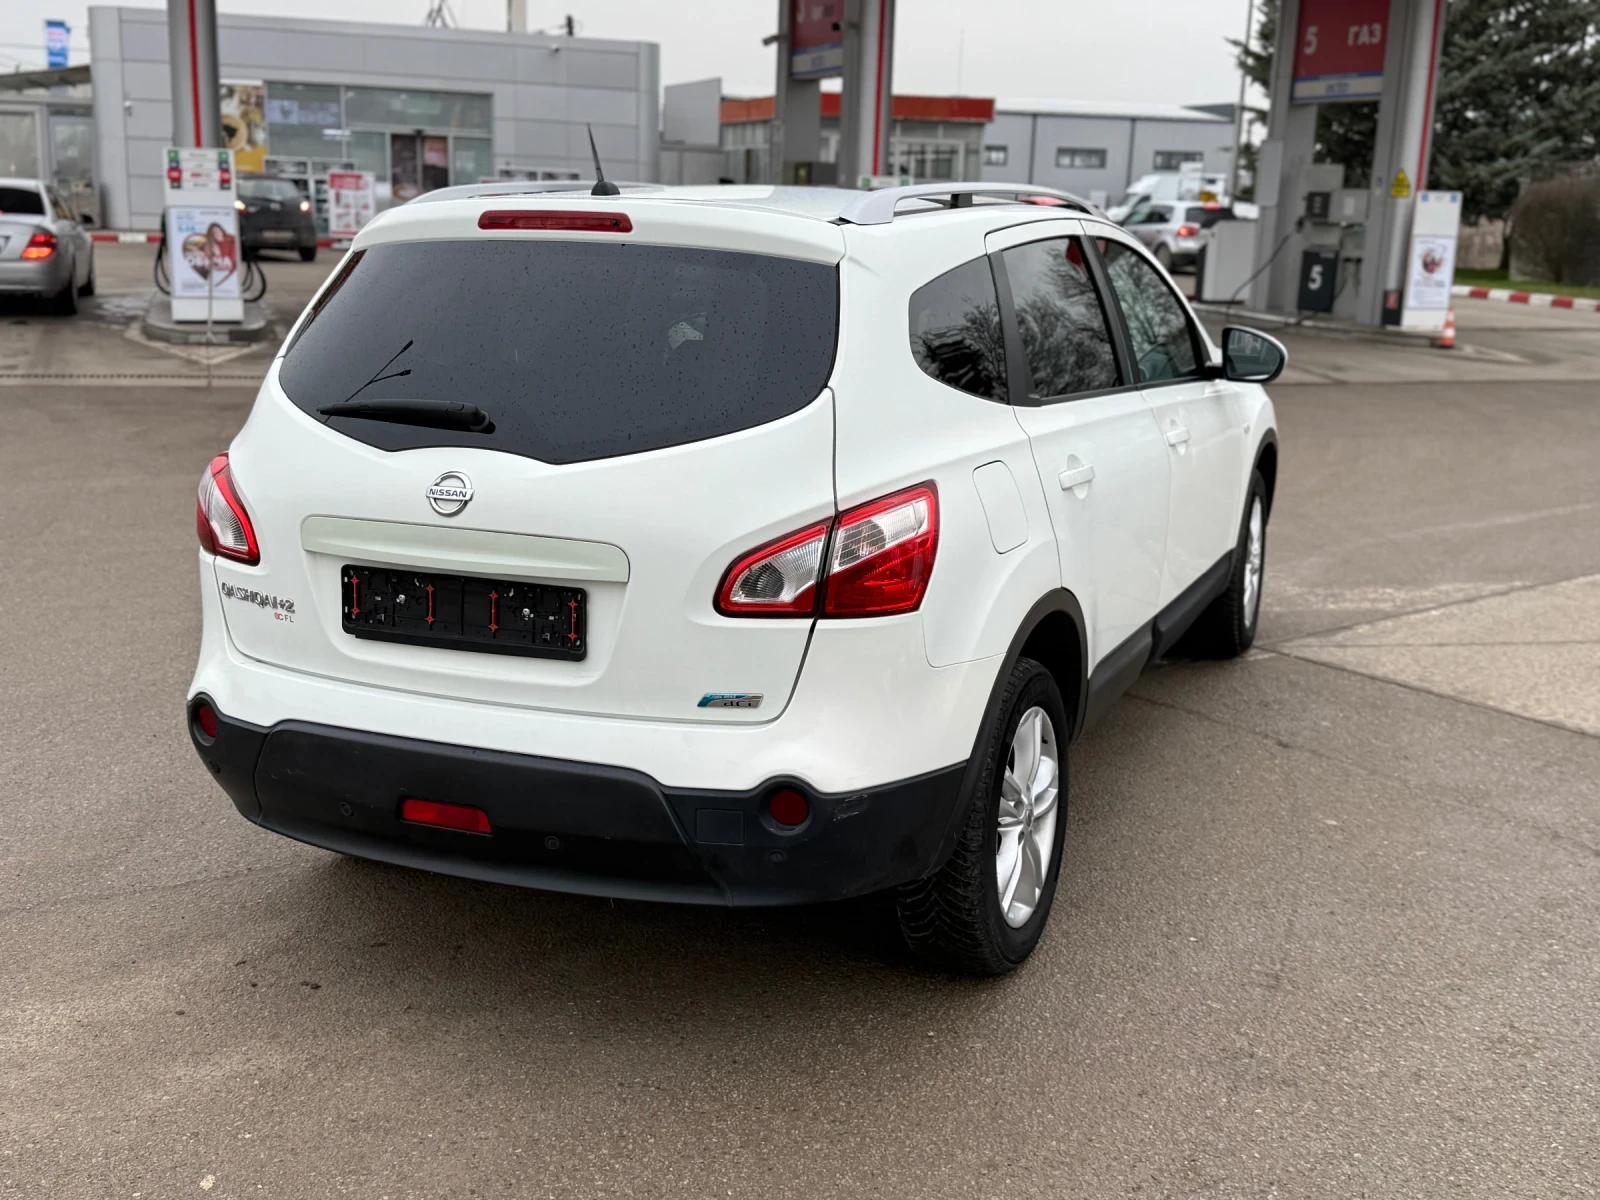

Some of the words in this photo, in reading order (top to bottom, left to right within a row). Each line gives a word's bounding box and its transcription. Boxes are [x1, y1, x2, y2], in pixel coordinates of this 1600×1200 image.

[1304, 25, 1319, 55] 5
[1347, 22, 1382, 47] ГАЗ
[1308, 264, 1323, 290] 5
[429, 488, 467, 498] NISSAN
